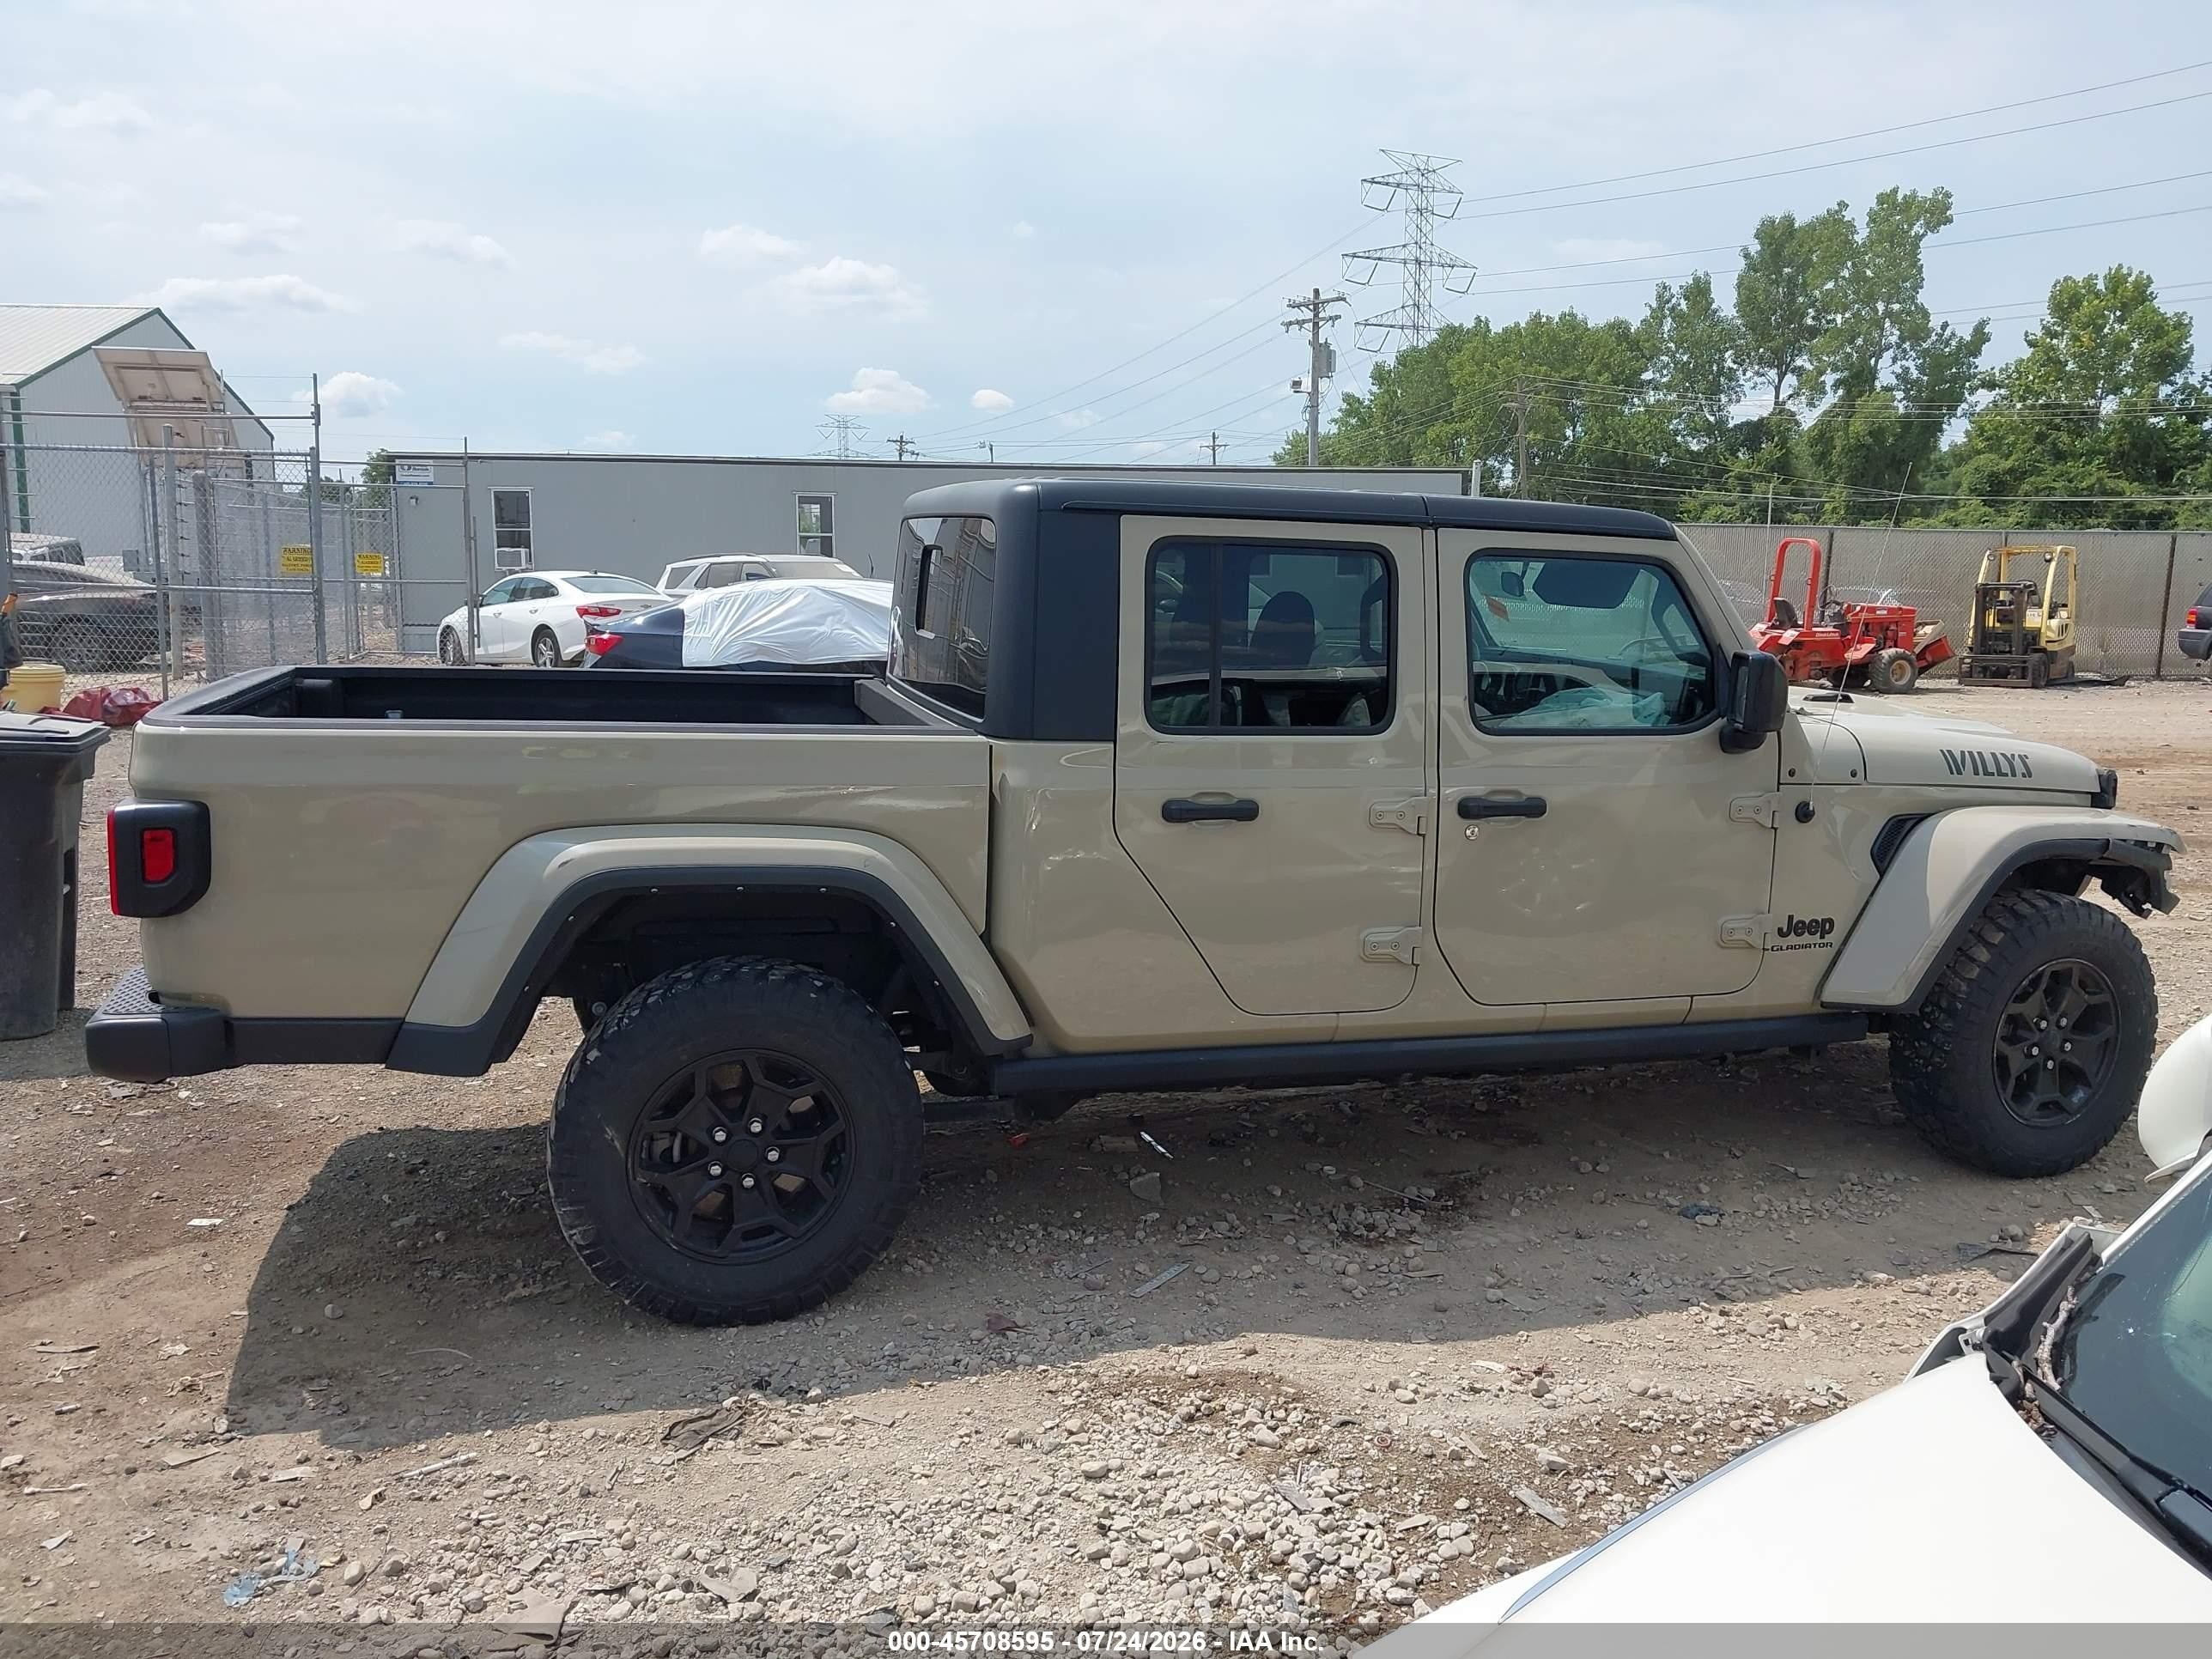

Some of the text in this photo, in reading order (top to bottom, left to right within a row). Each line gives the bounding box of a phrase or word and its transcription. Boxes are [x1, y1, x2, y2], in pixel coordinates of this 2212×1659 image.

[1939, 749, 2033, 779] WILLYS
[1777, 915, 1835, 940] Jeep
[1771, 941, 1833, 952] GLADIATOR
